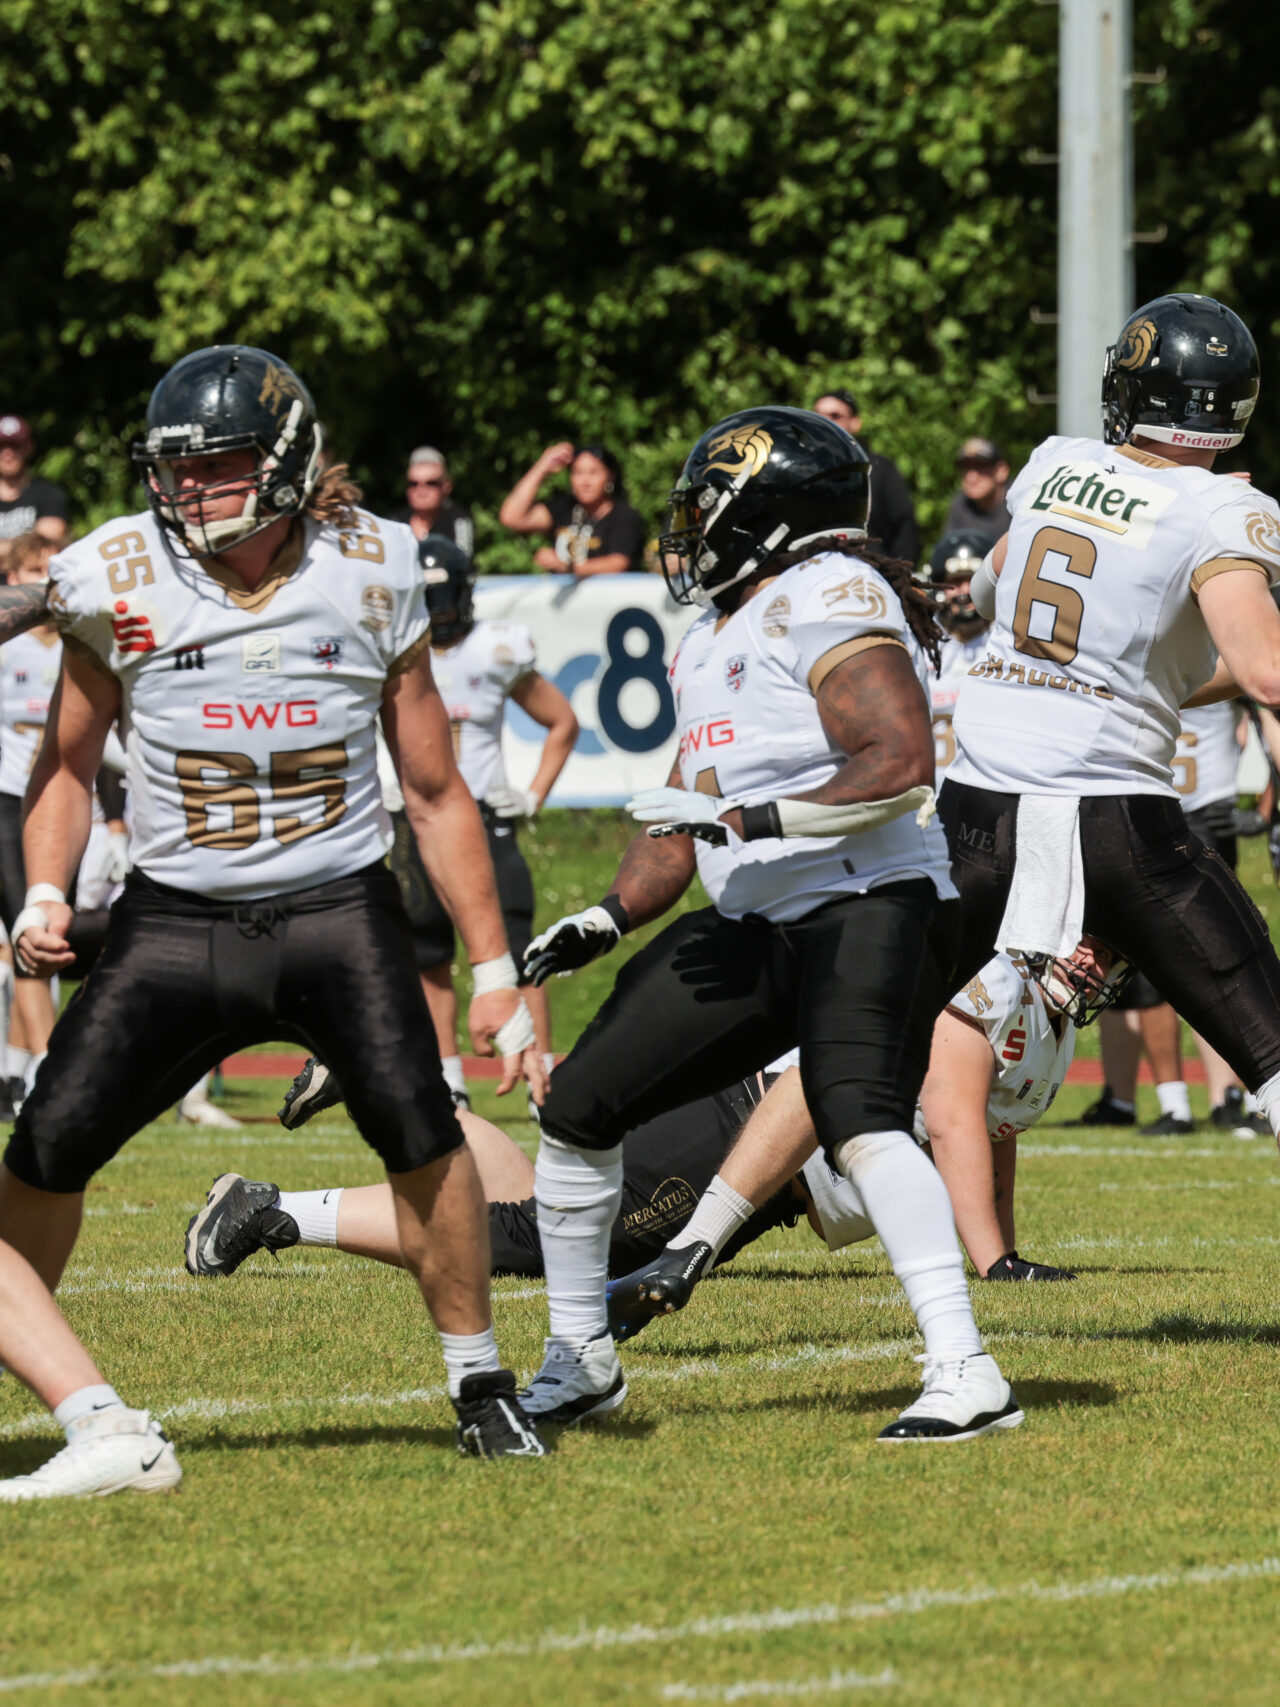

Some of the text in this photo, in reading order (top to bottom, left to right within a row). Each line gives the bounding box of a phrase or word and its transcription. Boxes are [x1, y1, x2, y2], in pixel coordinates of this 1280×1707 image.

[1172, 433, 1232, 448] Riddell
[1031, 465, 1149, 523] Licher
[98, 531, 156, 595] 65
[1012, 525, 1097, 666] 6
[202, 700, 318, 730] SWG
[174, 743, 348, 850] 65
[622, 1186, 691, 1230] MERCATUS
